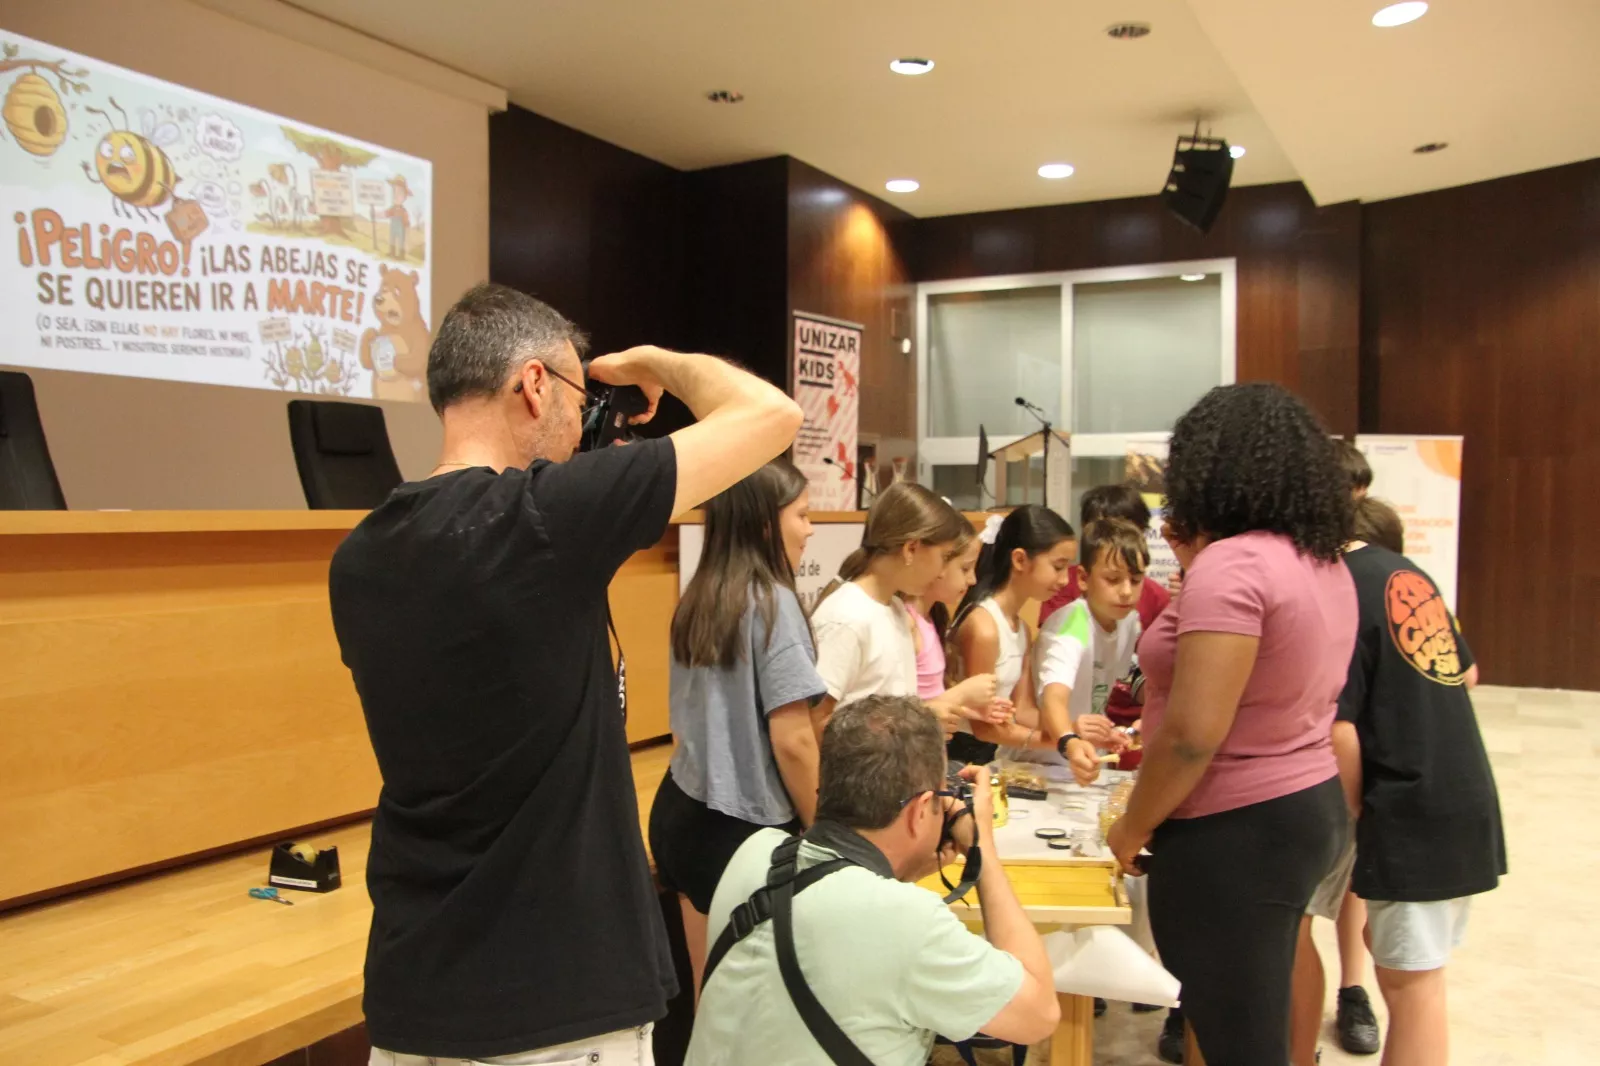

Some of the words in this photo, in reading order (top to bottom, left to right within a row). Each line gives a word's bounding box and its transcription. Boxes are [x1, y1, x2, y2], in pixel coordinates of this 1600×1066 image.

[200, 244, 251, 276] ¡LAS
[260, 245, 338, 279] ABEJAS
[345, 259, 369, 288] SE
[37, 271, 73, 306] SE
[85, 277, 200, 312] QUIEREN
[211, 282, 234, 311] IR
[244, 282, 259, 311] A
[267, 278, 364, 324] MARTE!
[111, 321, 140, 335] ELLAS
[800, 327, 856, 353] UNIZAR
[799, 358, 834, 380] KIDS
[808, 559, 820, 576] de
